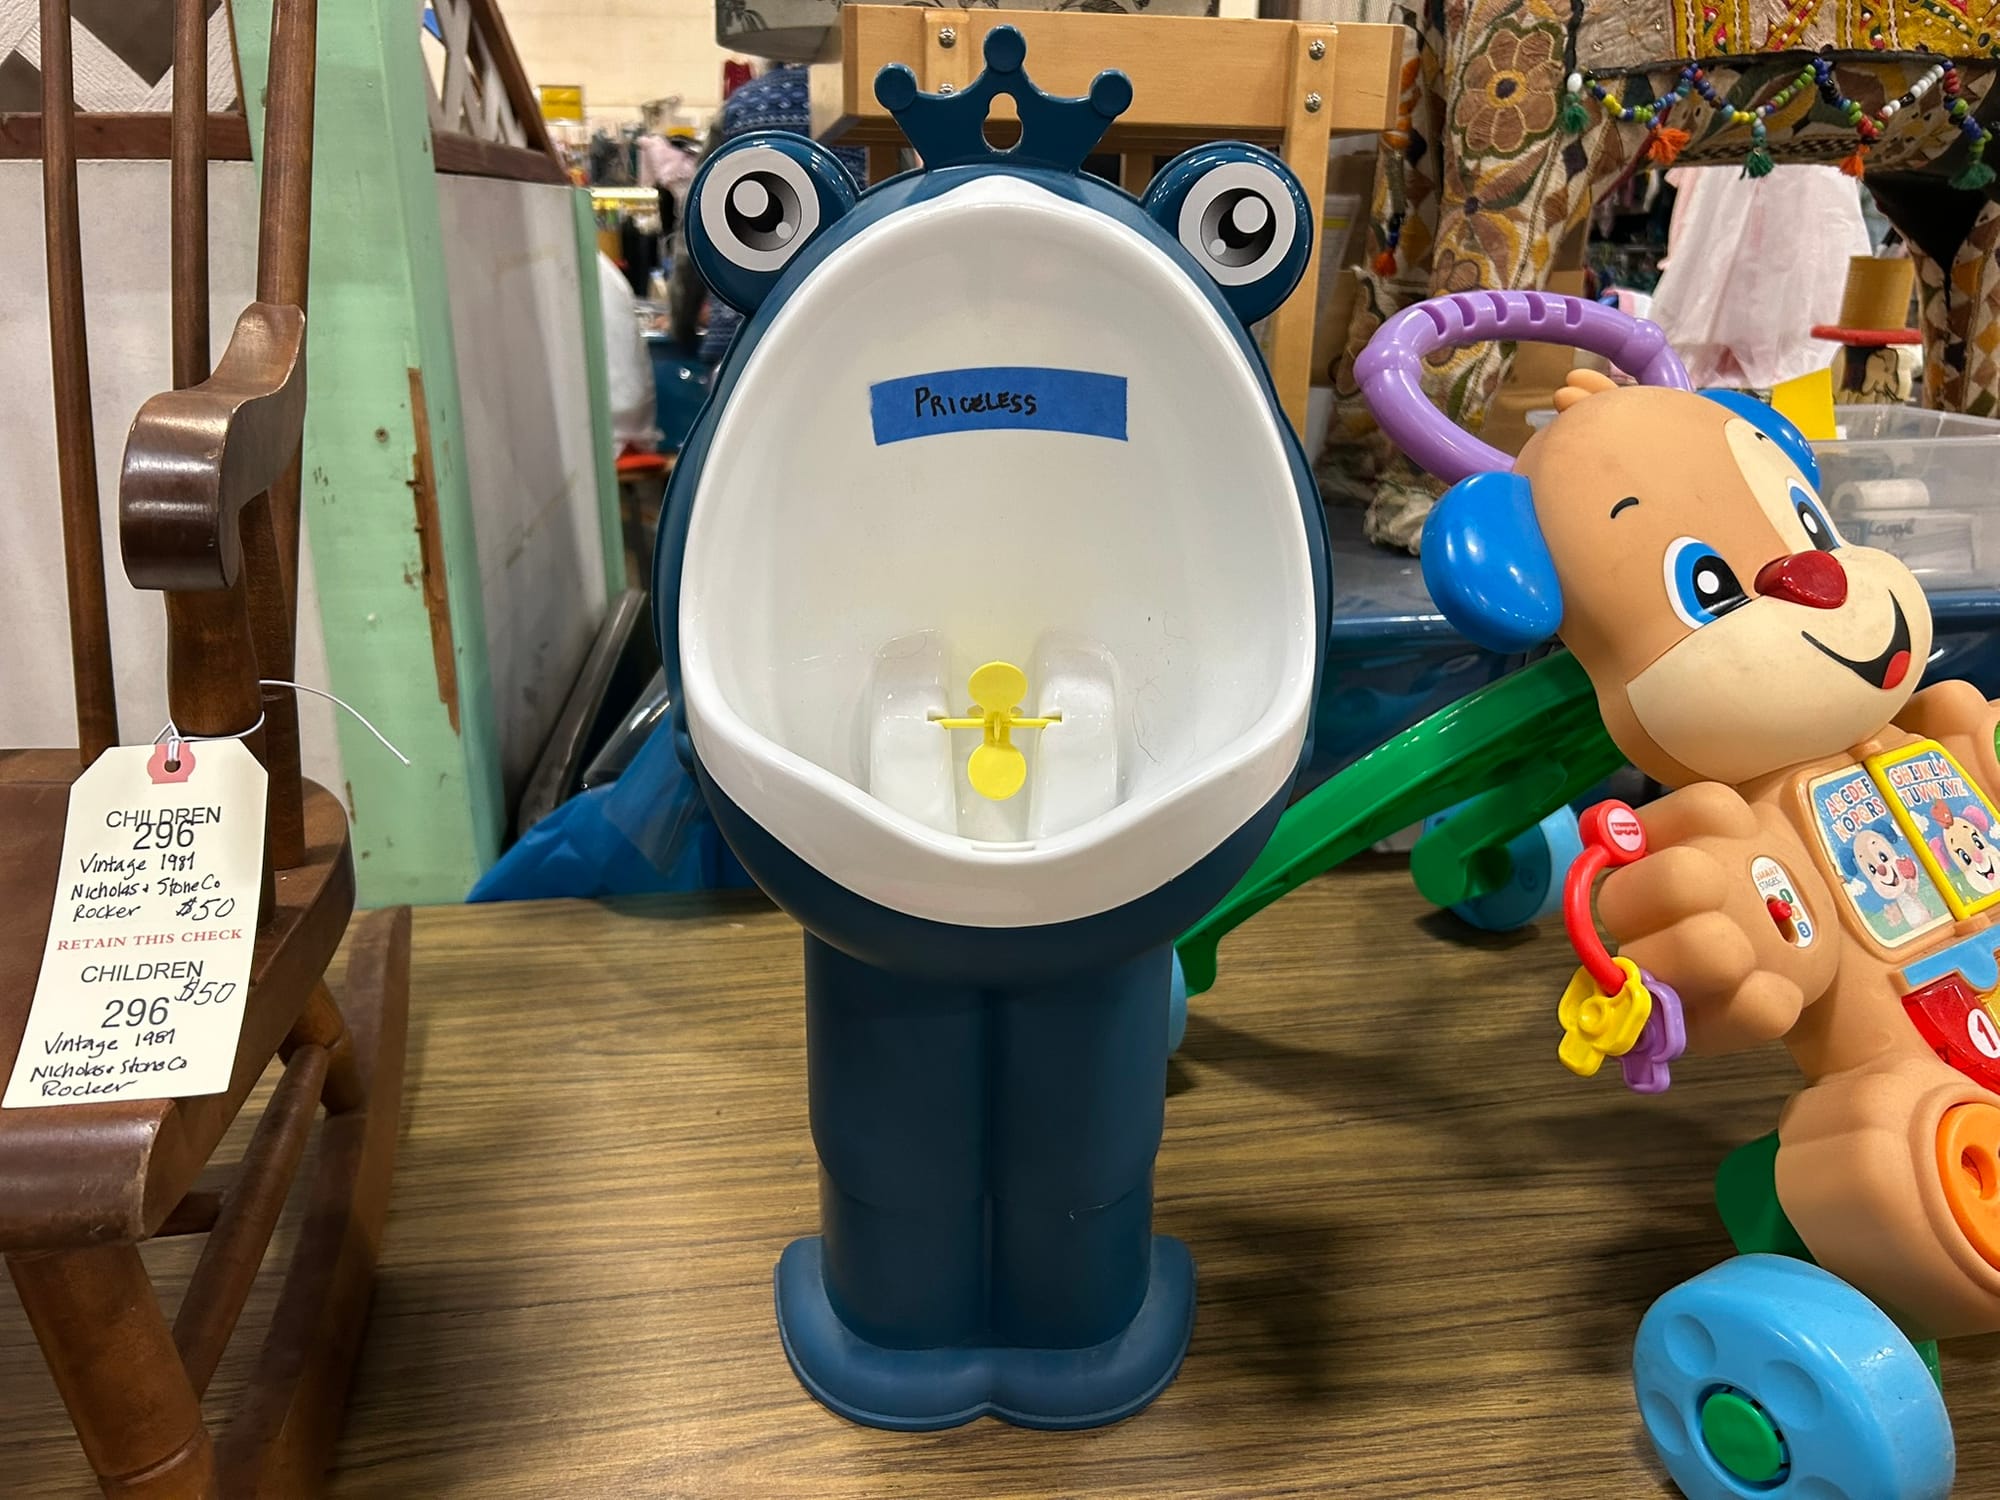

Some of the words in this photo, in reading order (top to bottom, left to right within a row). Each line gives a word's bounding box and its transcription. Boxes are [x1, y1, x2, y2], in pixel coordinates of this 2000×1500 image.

[1825, 776, 1872, 819] ABCDEF
[106, 806, 221, 827] CHILDREN
[1833, 798, 1886, 842] NOPQRS
[133, 820, 195, 850] 296
[80, 853, 147, 880] Vintage
[73, 904, 141, 922] Rocker
[176, 897, 235, 921] $50
[57, 937, 127, 951] RETAIN
[134, 933, 175, 946] THIS
[181, 929, 243, 943] CHECK
[81, 960, 204, 983] CHILDREN
[174, 976, 236, 1006] $50
[101, 997, 170, 1028] 296
[45, 1032, 118, 1059] Vintage
[1977, 1015, 1998, 1051] 1
